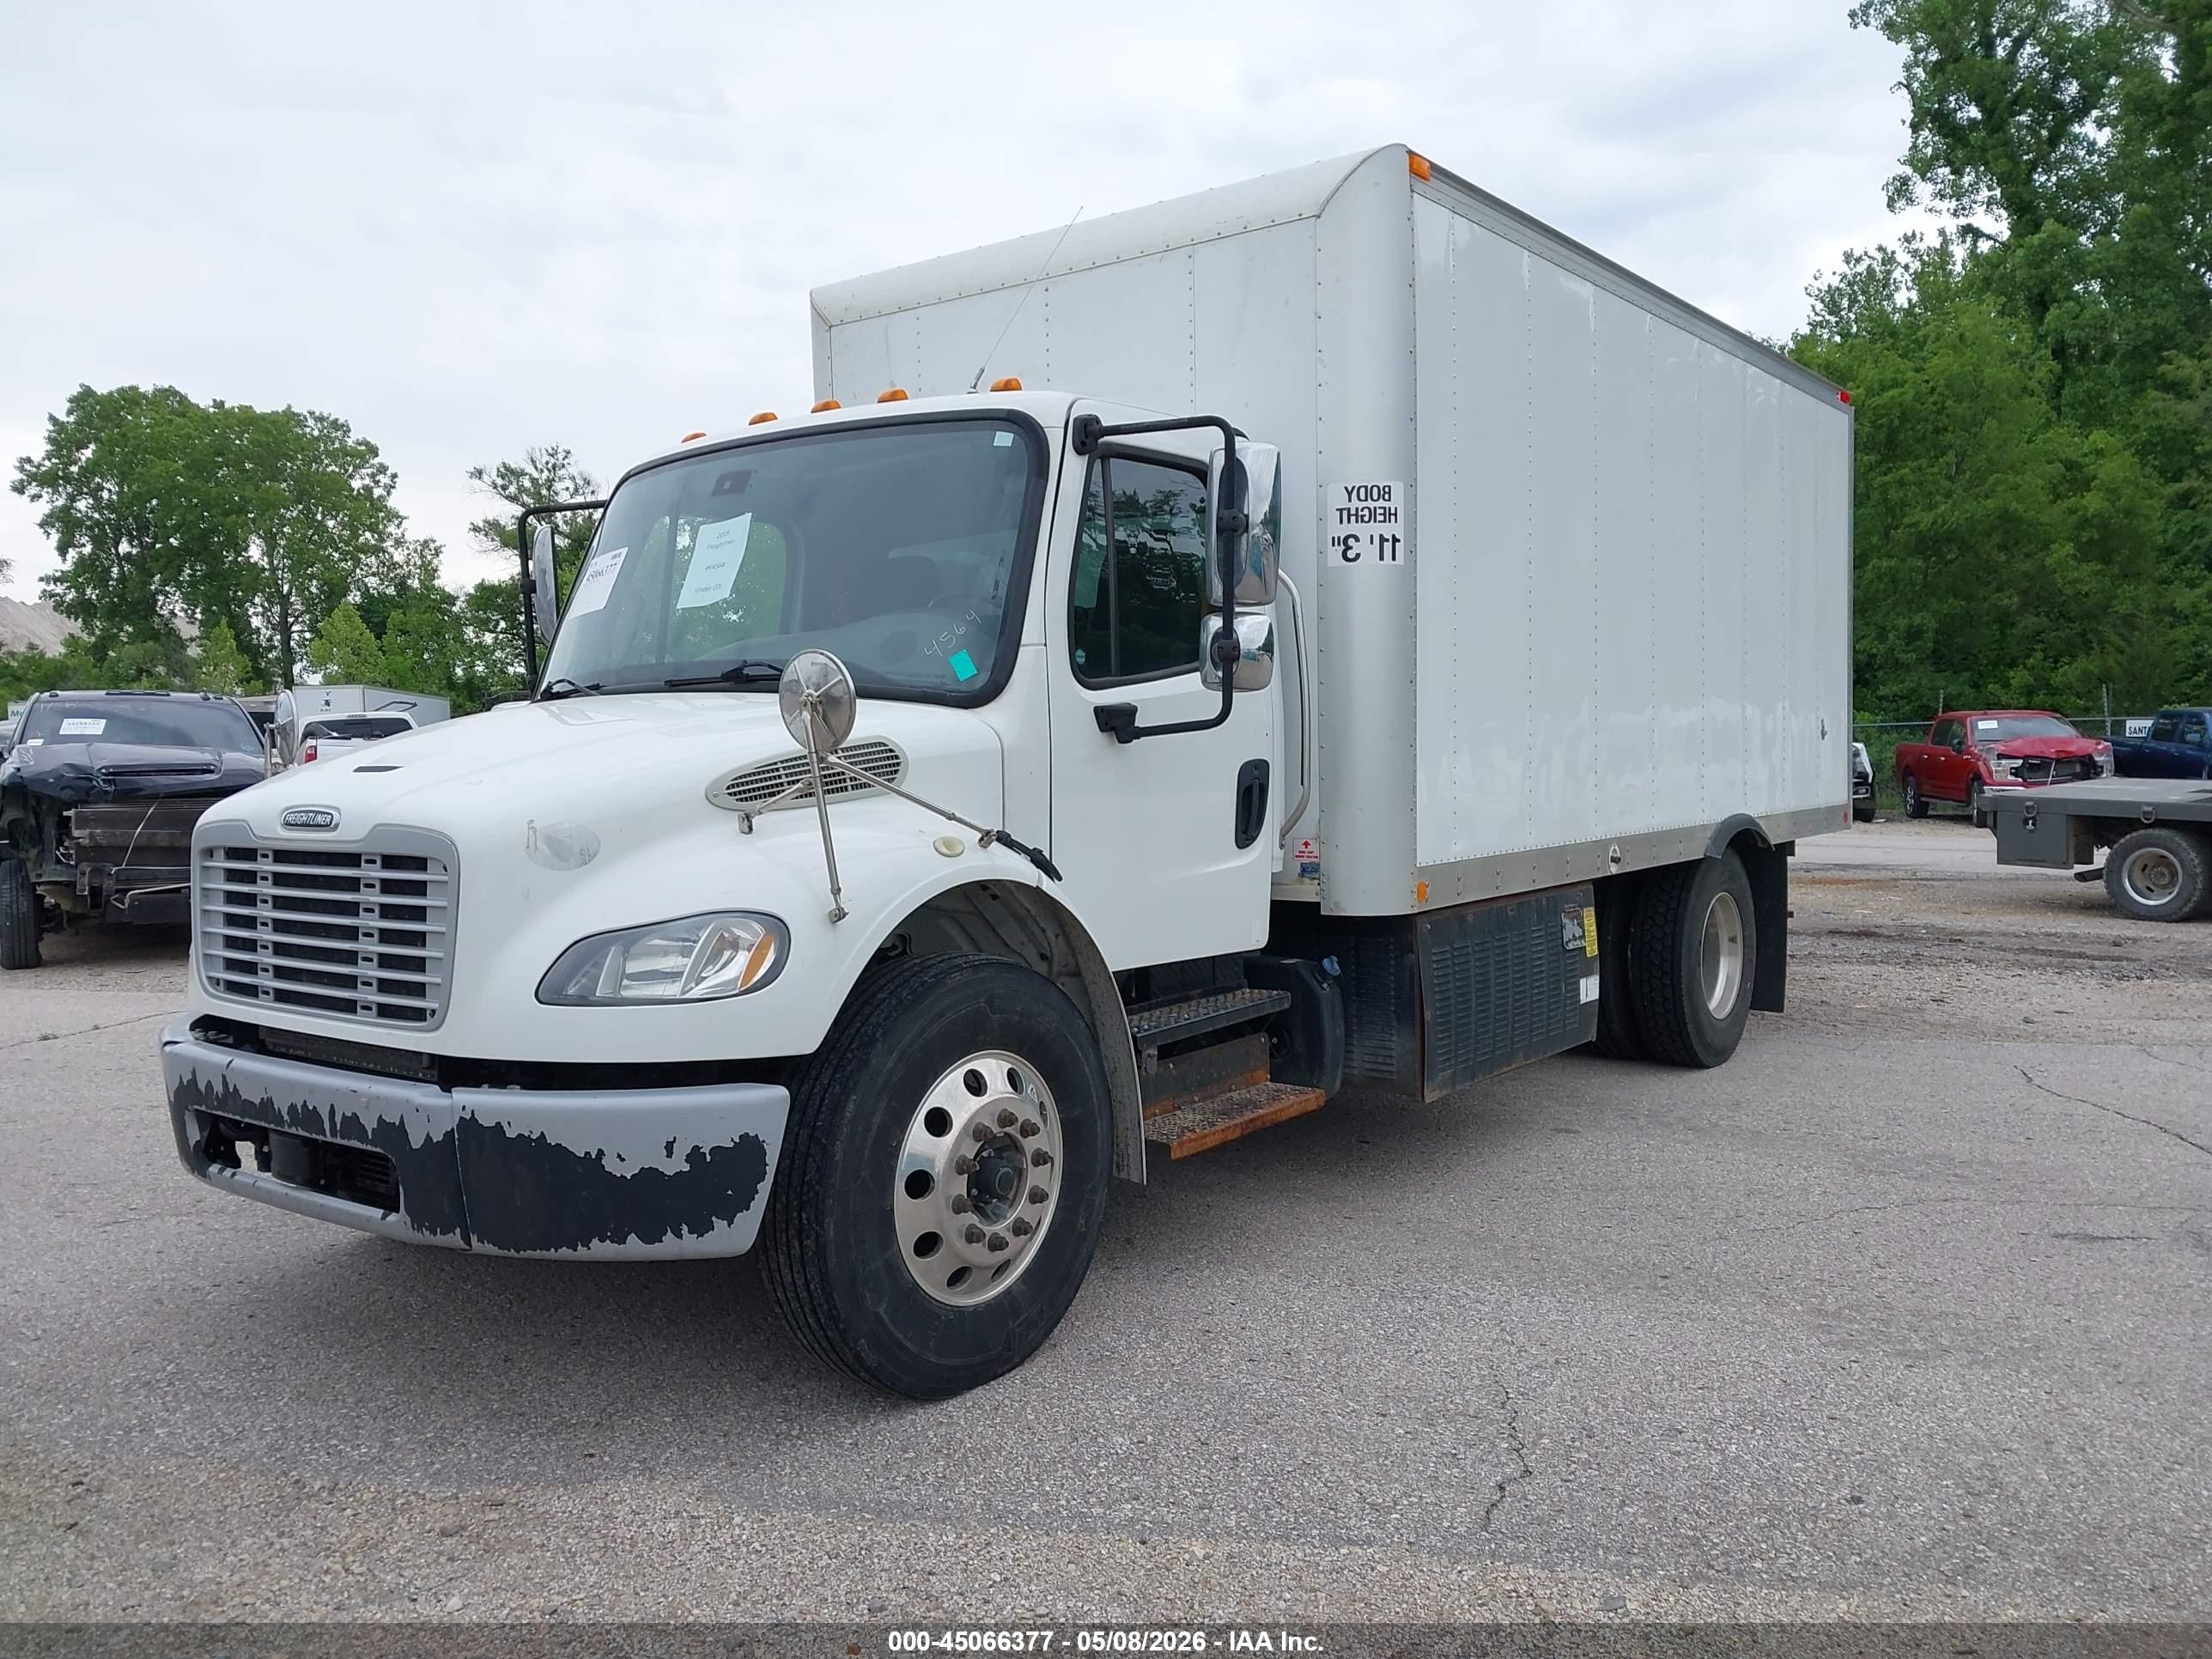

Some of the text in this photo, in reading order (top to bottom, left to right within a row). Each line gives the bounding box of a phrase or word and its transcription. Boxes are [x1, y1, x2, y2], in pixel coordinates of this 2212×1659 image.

[924, 610, 981, 657] 4564
[2128, 726, 2151, 736] SANT
[283, 812, 332, 825] FREIGHTLINER
